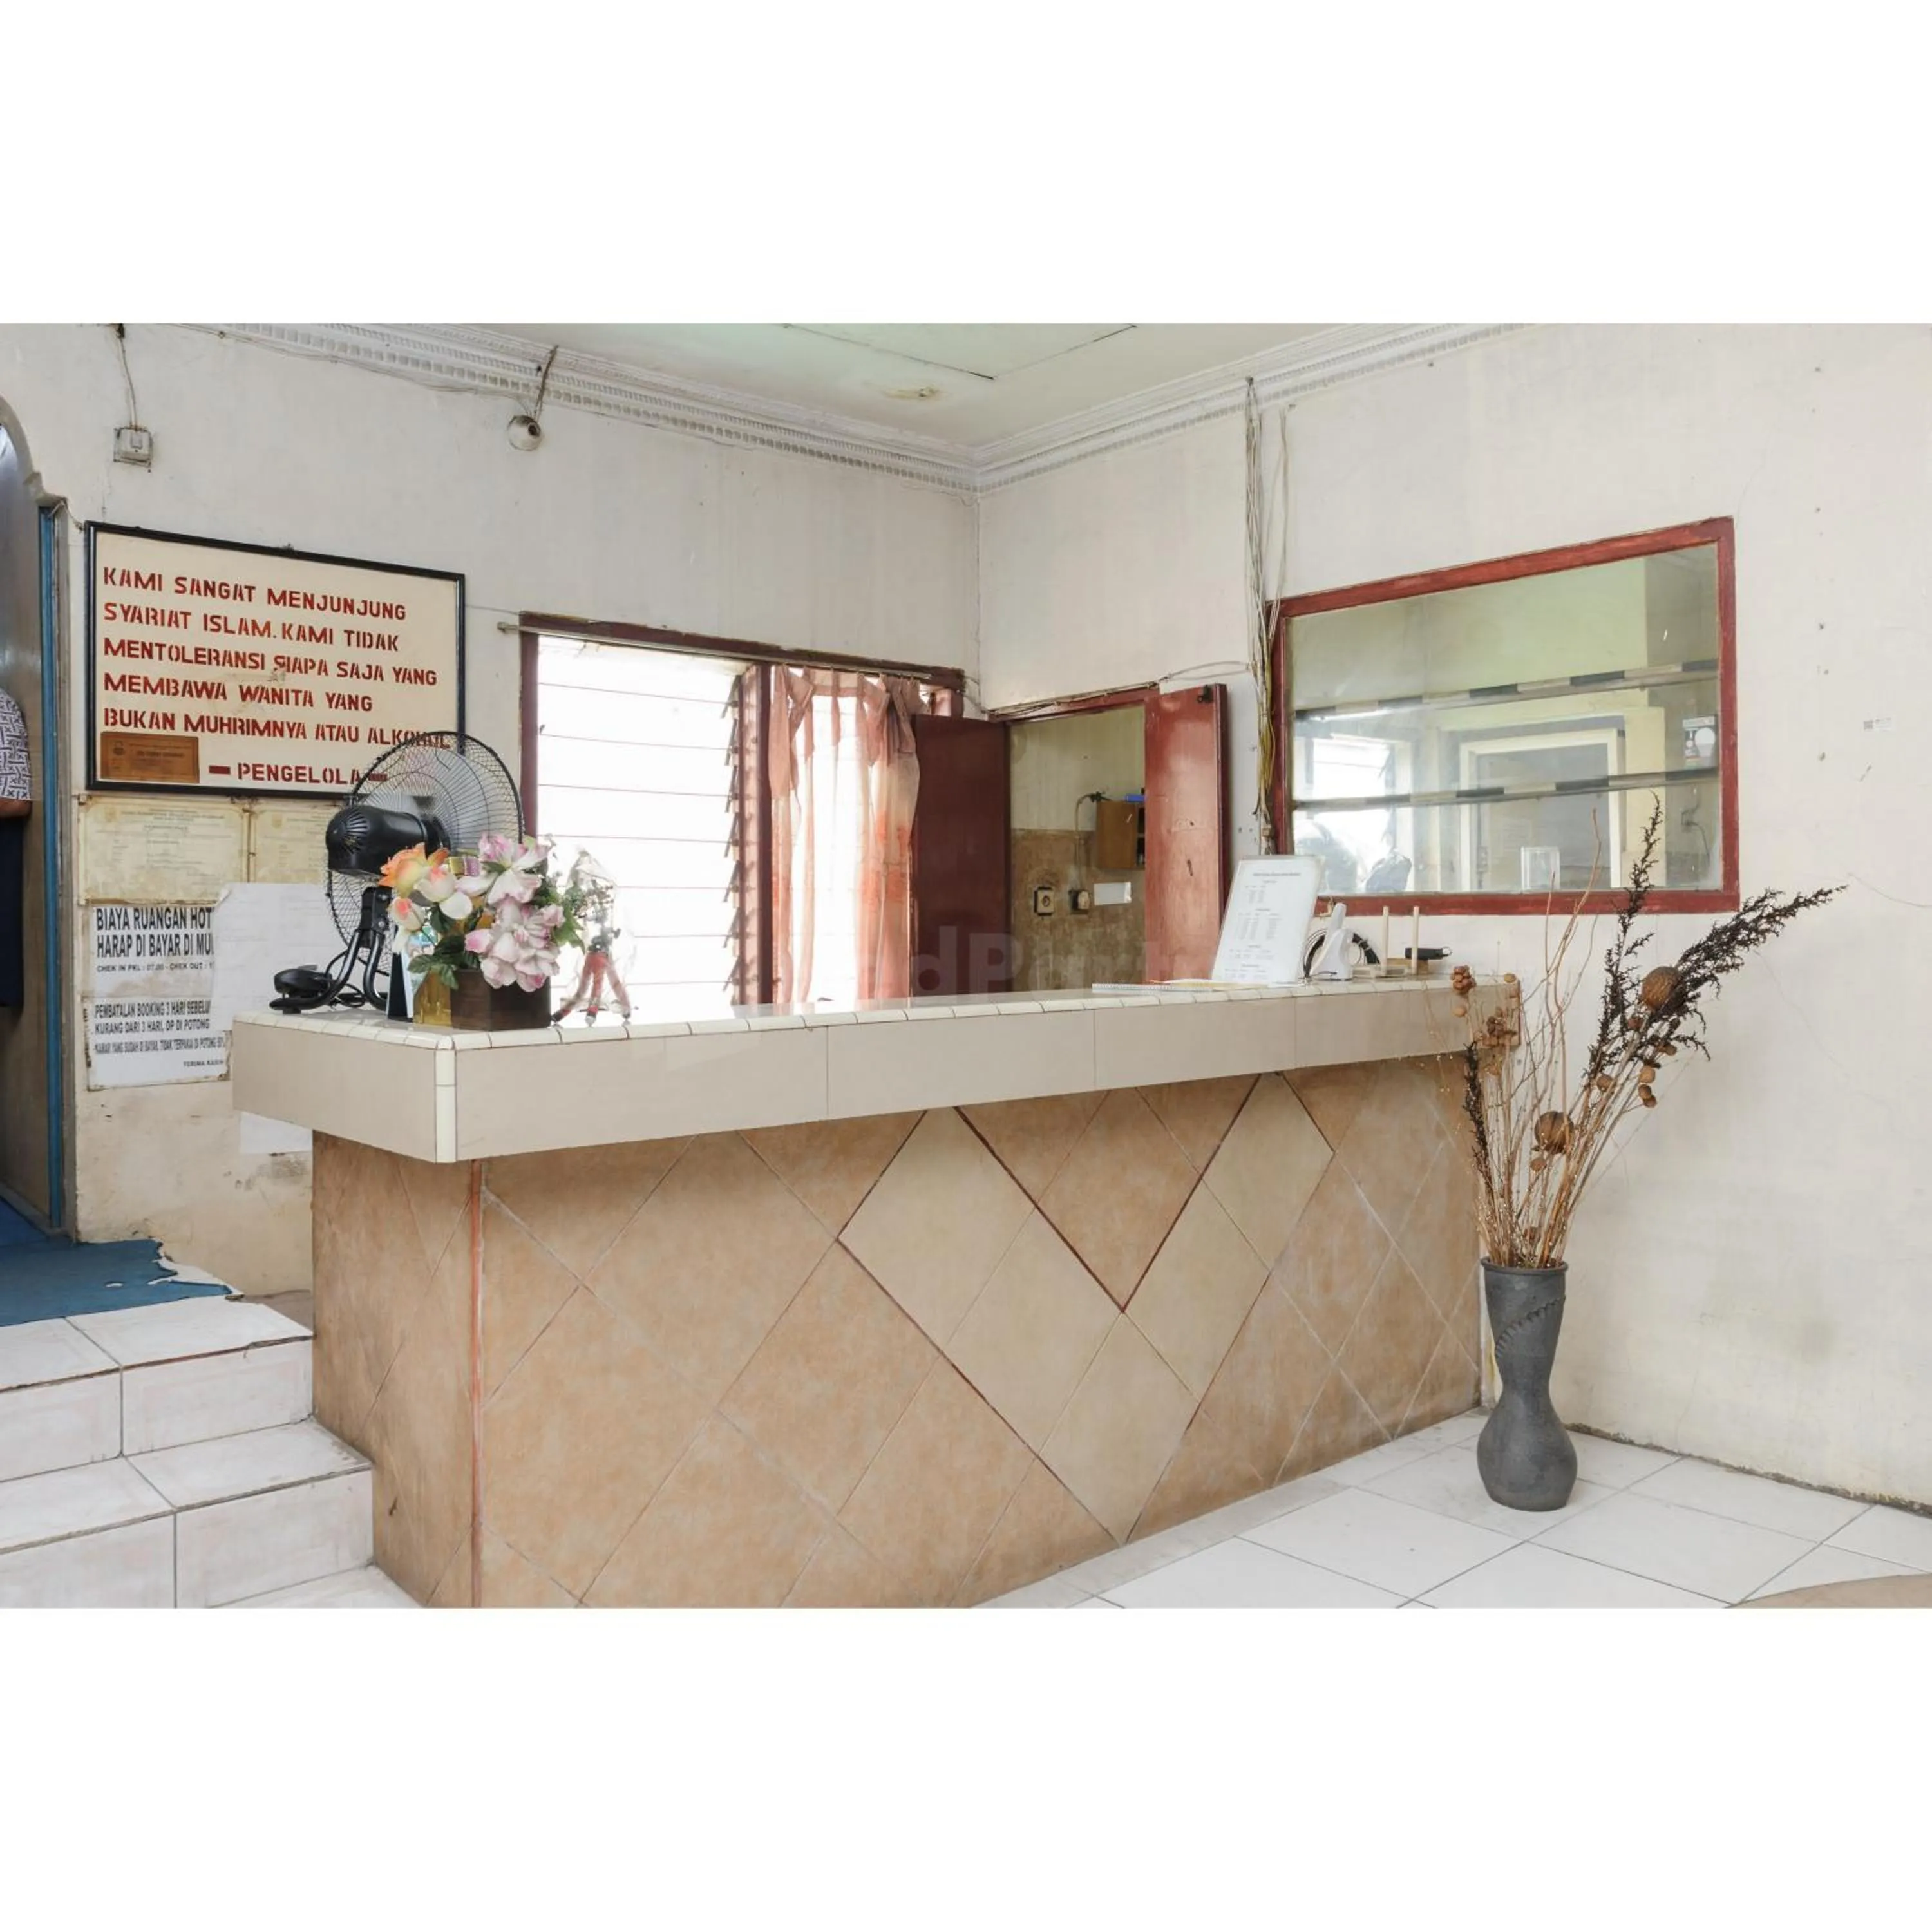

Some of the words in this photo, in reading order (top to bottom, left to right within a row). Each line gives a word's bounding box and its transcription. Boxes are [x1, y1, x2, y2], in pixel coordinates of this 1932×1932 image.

[103, 567, 163, 592] KAMI
[174, 576, 257, 603] SANGAT
[267, 587, 407, 621] MENJUNJUNG
[103, 602, 192, 630] SYARIAT
[281, 622, 334, 646] KAMI
[343, 629, 399, 652] TIDAK
[103, 637, 266, 671] MENTOLERANSI
[272, 654, 330, 678] SIAPA
[336, 661, 384, 683] SAJA
[392, 666, 438, 687] YANG
[103, 672, 227, 703] MEMBAWA
[238, 683, 314, 708] WANITA
[325, 691, 374, 712] YANG
[103, 708, 176, 731] BUKAN
[184, 714, 307, 741] MUHRIMNYA
[315, 723, 360, 743] ATAU
[237, 762, 361, 784] PENGELOLA
[97, 907, 130, 931] BIAYA
[133, 907, 187, 930] RUANGAN
[191, 906, 214, 929] HOT
[97, 934, 132, 958] HARAP
[136, 934, 146, 957] DI
[149, 933, 180, 956] BAYAR
[184, 933, 194, 956] DI
[196, 933, 214, 956] MU
[95, 1002, 136, 1019] PEMBATALAN
[137, 1001, 164, 1017] BOOKING
[171, 1001, 185, 1016] HARI
[95, 1021, 123, 1035] KURANG
[124, 1020, 140, 1034] DARI
[166, 1019, 175, 1032] DP
[176, 1019, 183, 1031] DI
[184, 1018, 210, 1030] POTONG
